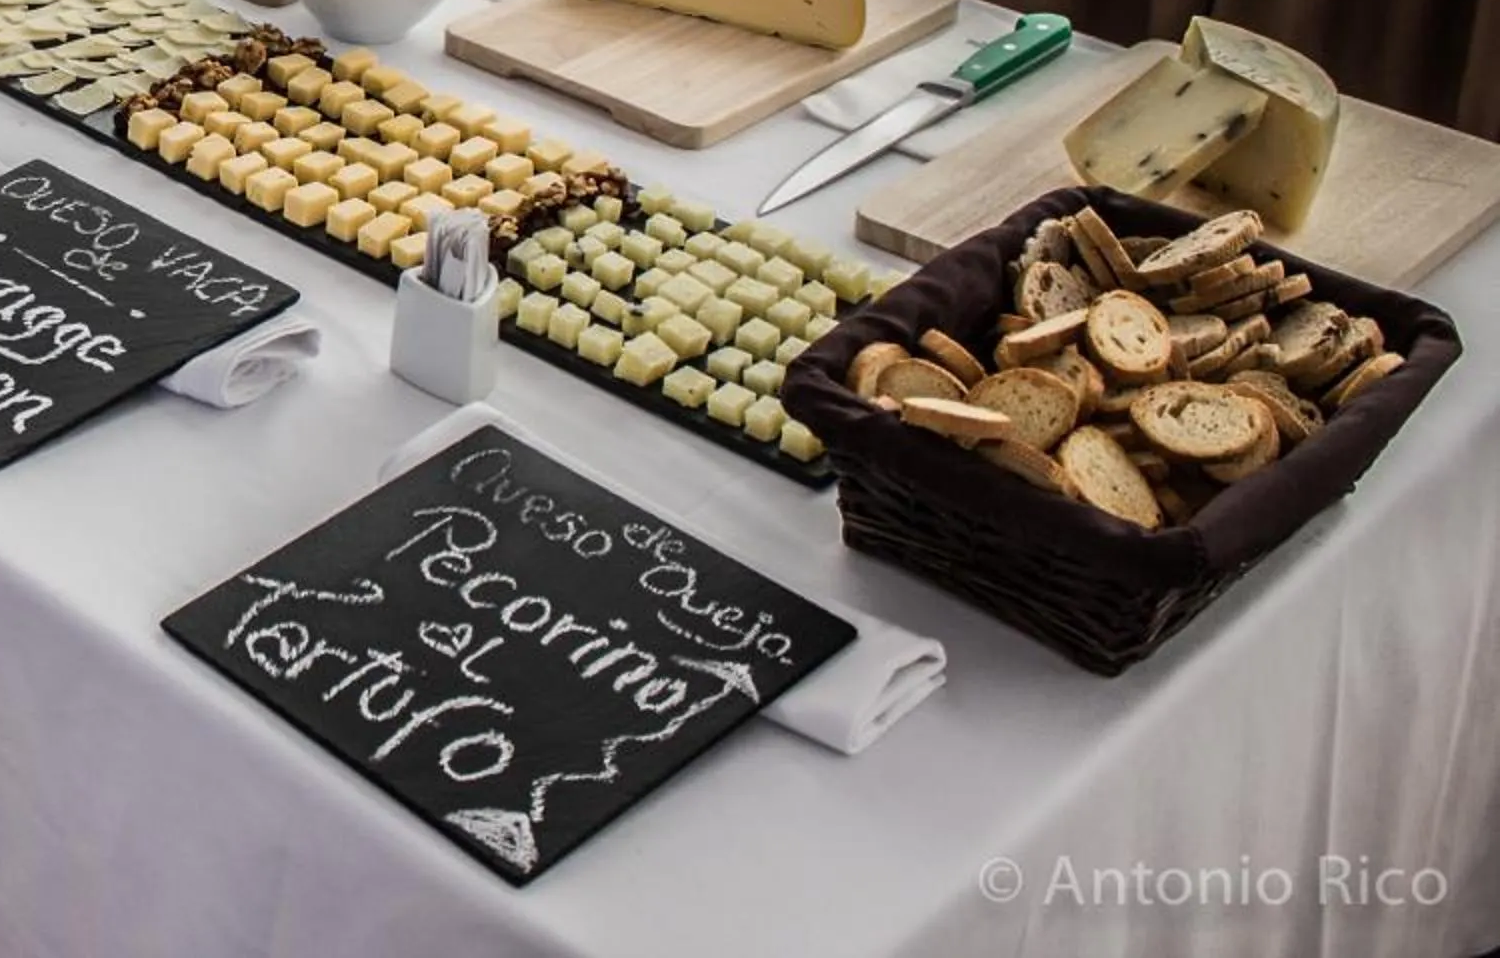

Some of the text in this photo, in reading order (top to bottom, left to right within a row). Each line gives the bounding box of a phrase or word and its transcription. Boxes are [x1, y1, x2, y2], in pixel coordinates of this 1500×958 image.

[0, 175, 270, 317] QUESO de VACA
[384, 505, 688, 712] Pecorino
[621, 521, 686, 564] de
